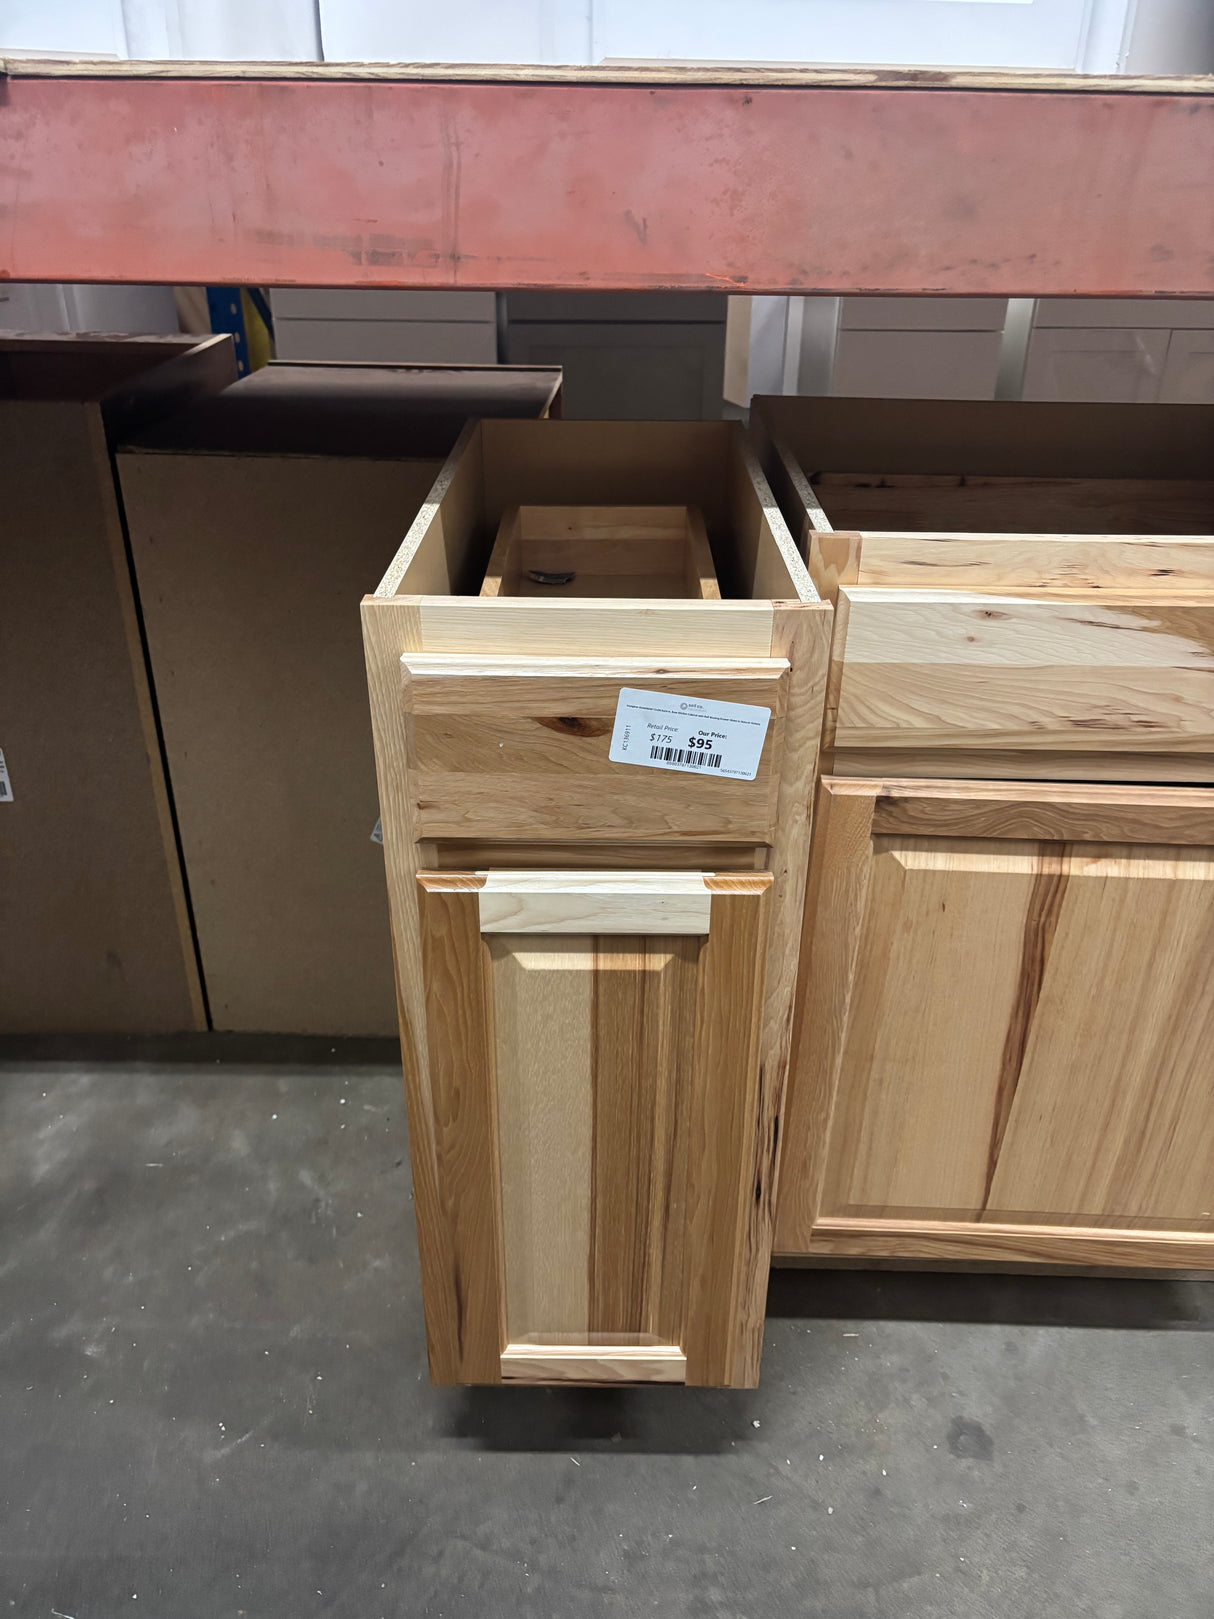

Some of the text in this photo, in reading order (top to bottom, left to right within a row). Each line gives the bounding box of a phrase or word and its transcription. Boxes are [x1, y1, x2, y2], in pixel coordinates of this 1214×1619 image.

[647, 722, 663, 730] Retail
[650, 733, 672, 744] $175
[688, 736, 712, 750] $95
